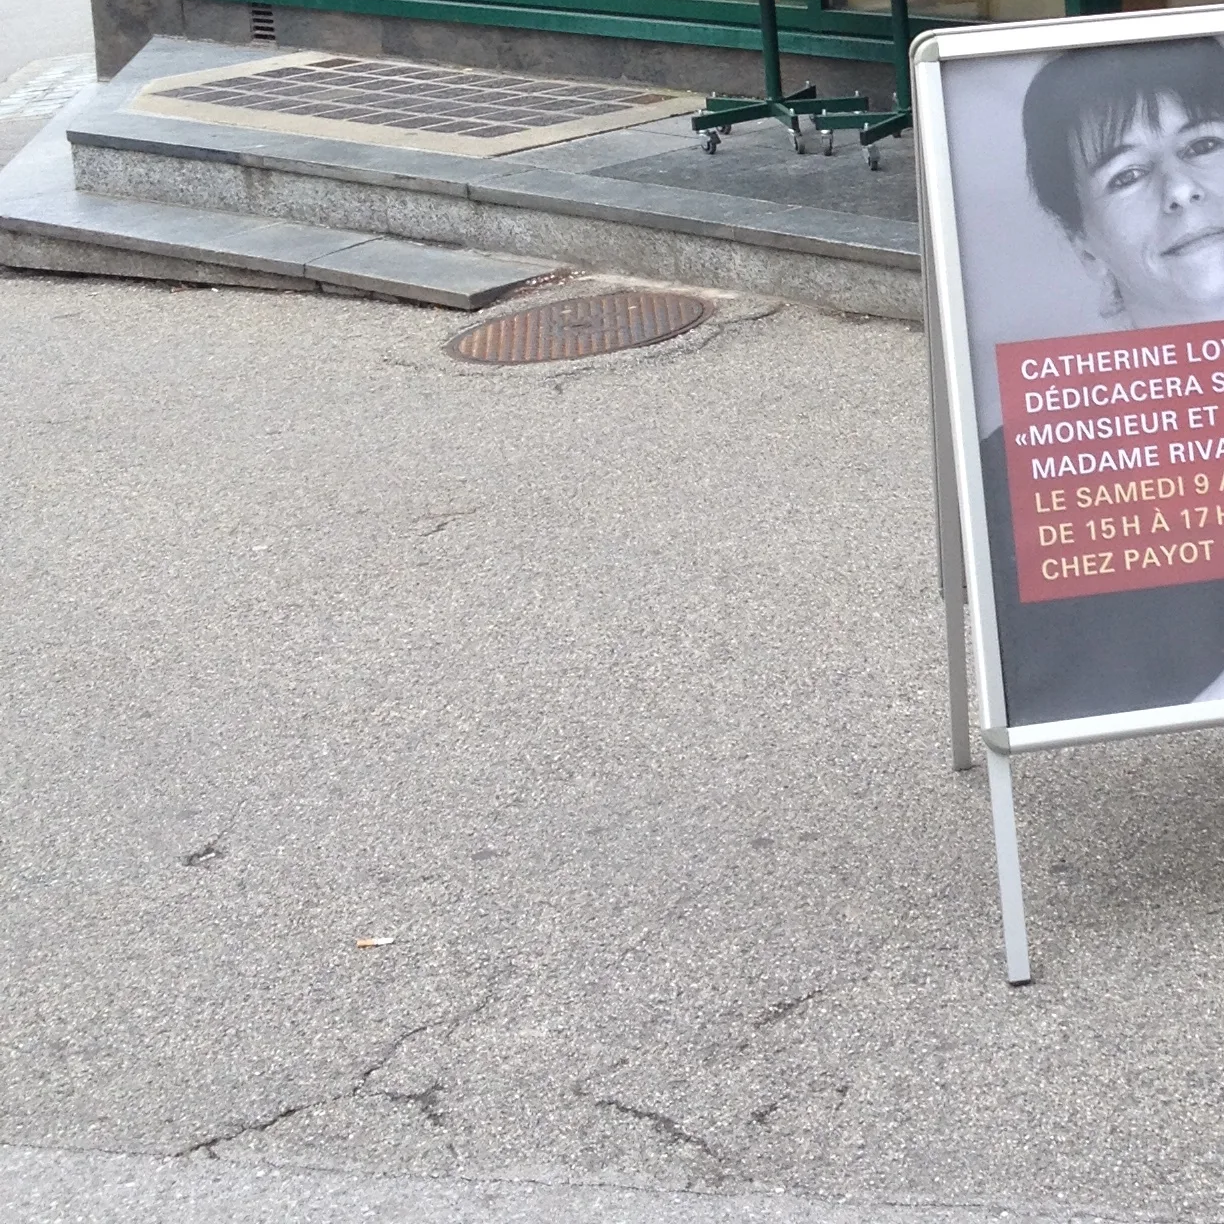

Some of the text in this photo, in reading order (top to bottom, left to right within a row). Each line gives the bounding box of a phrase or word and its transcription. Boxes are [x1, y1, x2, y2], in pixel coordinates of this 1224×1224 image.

[1020, 344, 1177, 381] CATHERINE
[1025, 374, 1203, 413] DÉDICACERA
[1015, 405, 1219, 447] «MONSIEUR ET
[1031, 445, 1160, 479] MADAME
[1035, 490, 1066, 514] LE
[1076, 478, 1185, 509] SAMEDI
[1195, 473, 1209, 495] 9
[1038, 523, 1074, 546] DE
[1151, 506, 1170, 533] À
[1042, 555, 1116, 580] CHEZ
[1124, 540, 1215, 571] PAYOT
